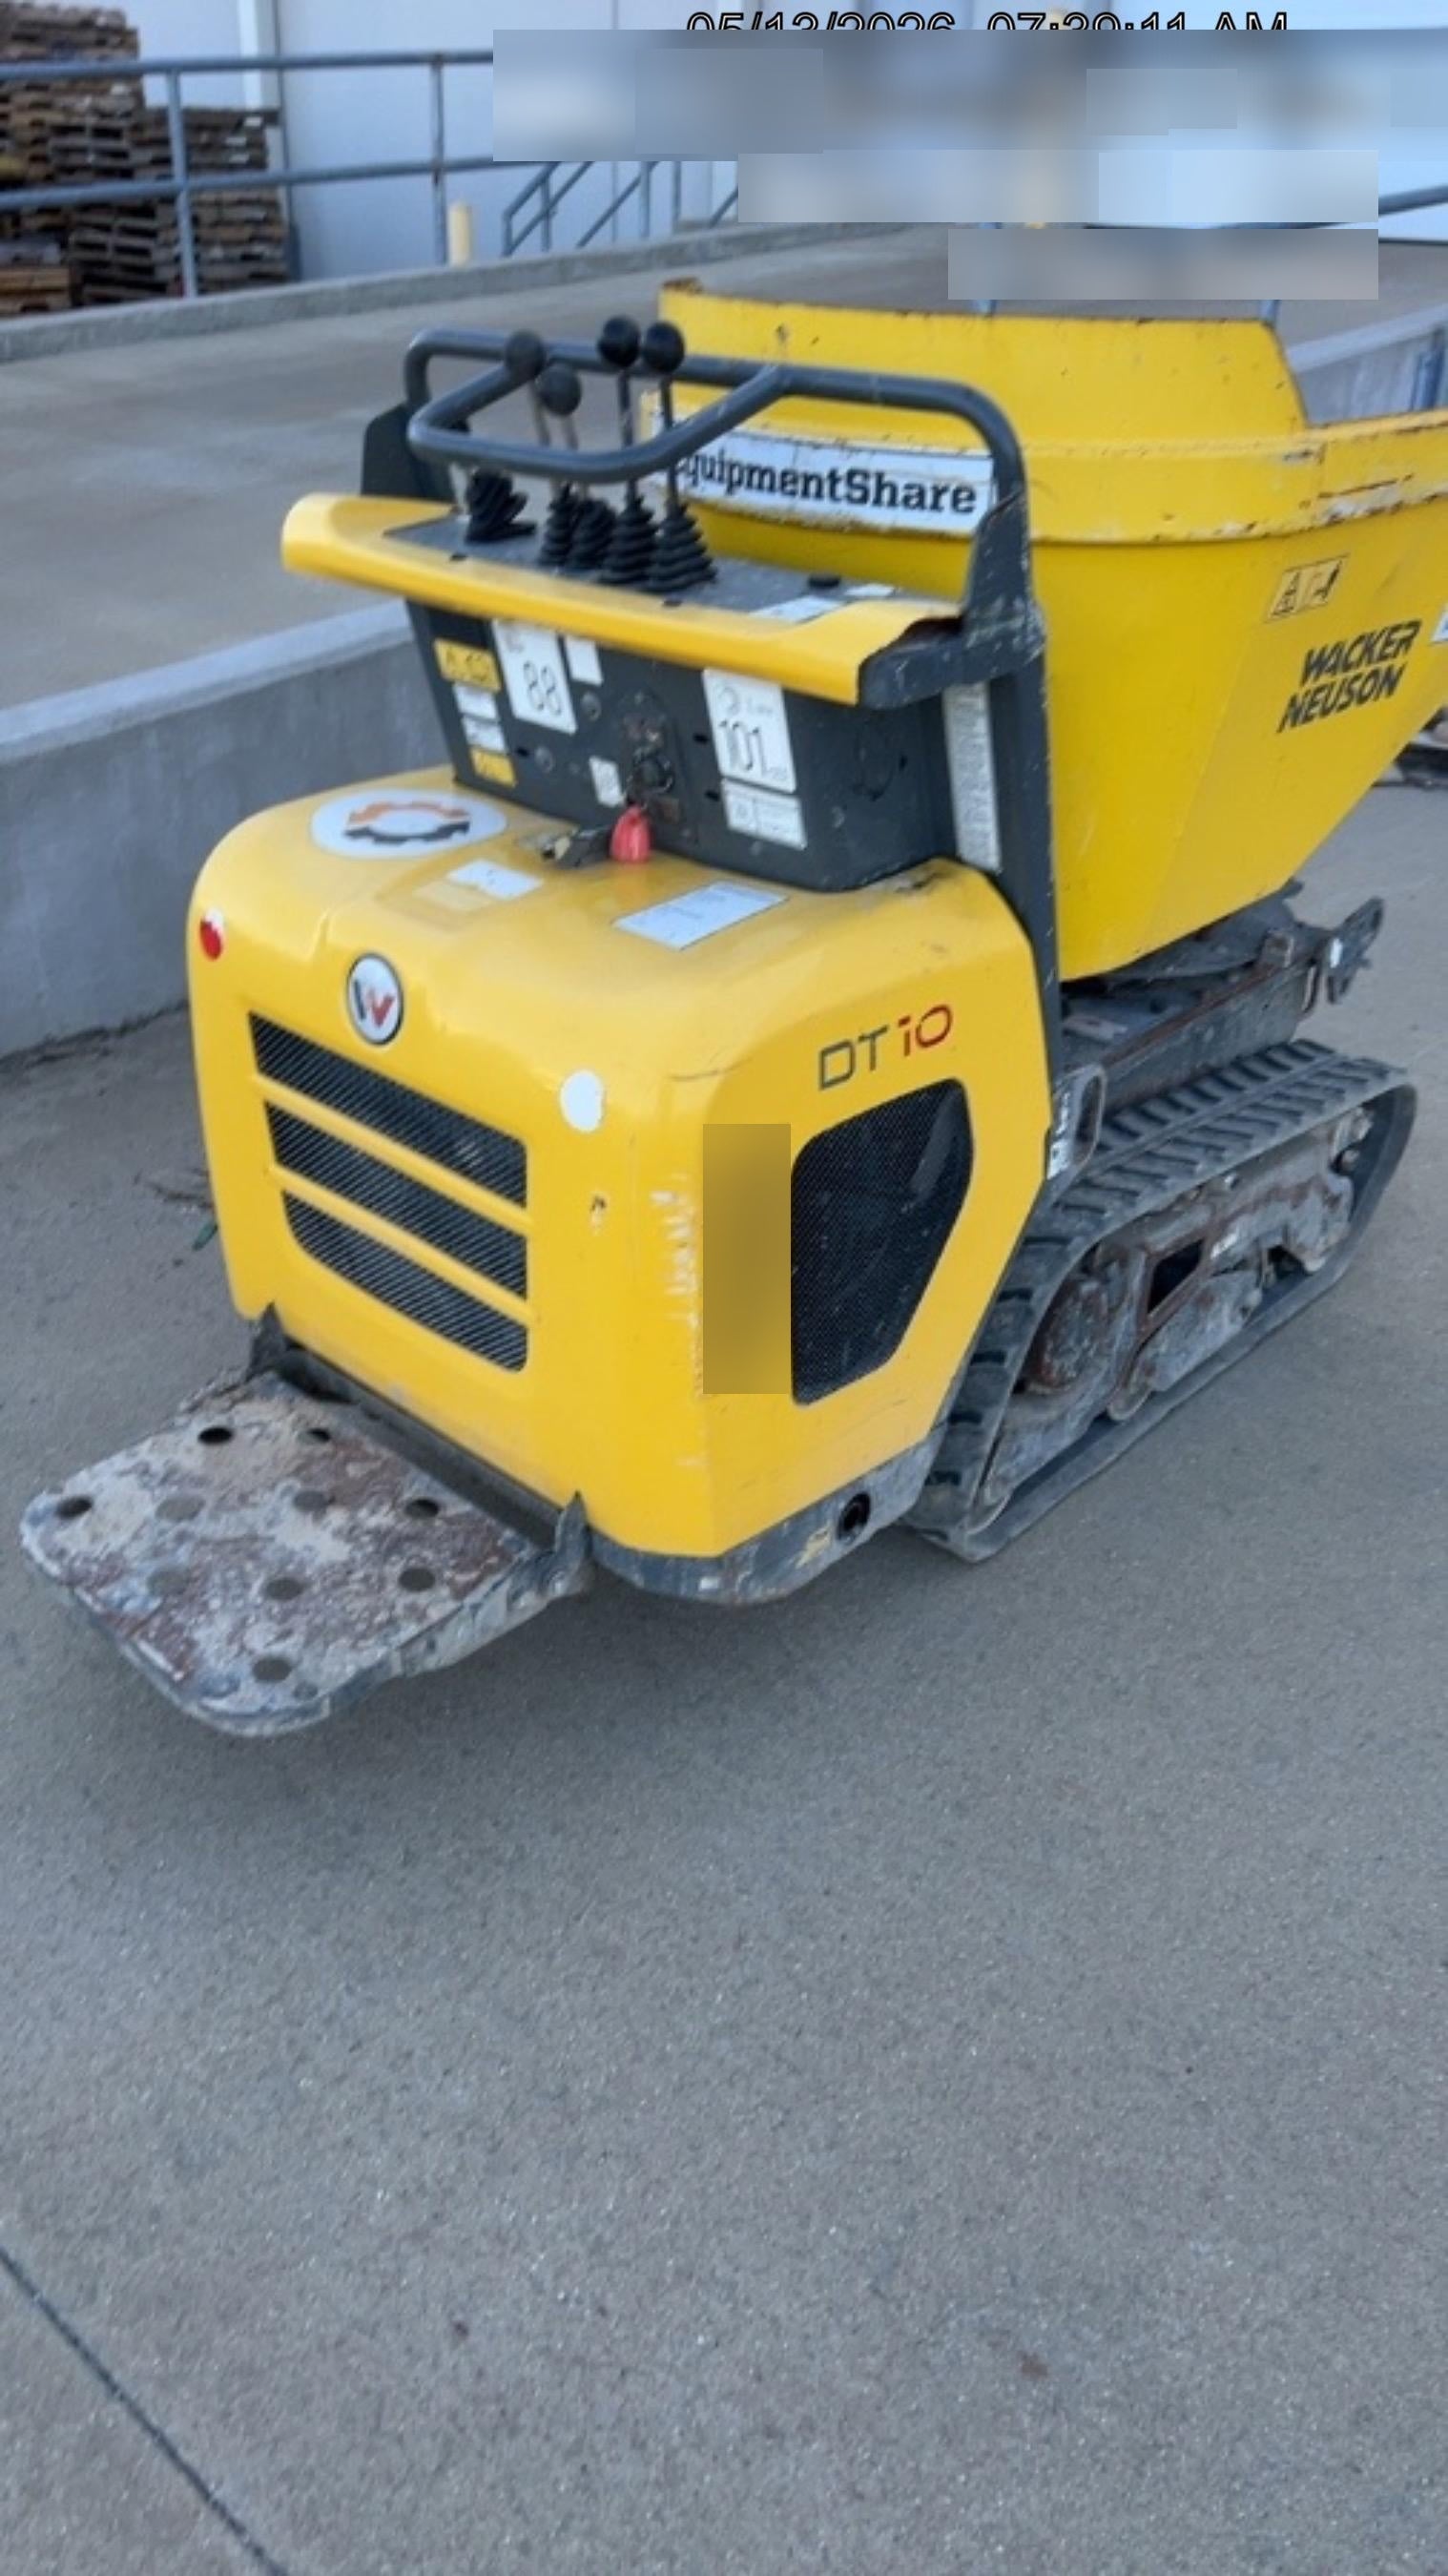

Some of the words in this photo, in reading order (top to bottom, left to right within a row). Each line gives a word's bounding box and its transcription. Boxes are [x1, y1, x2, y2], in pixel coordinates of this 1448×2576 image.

[676, 446, 977, 513] quipmentShare
[1300, 619, 1422, 686] WACKER
[523, 659, 563, 717] 88
[1276, 662, 1408, 734] NEUSON
